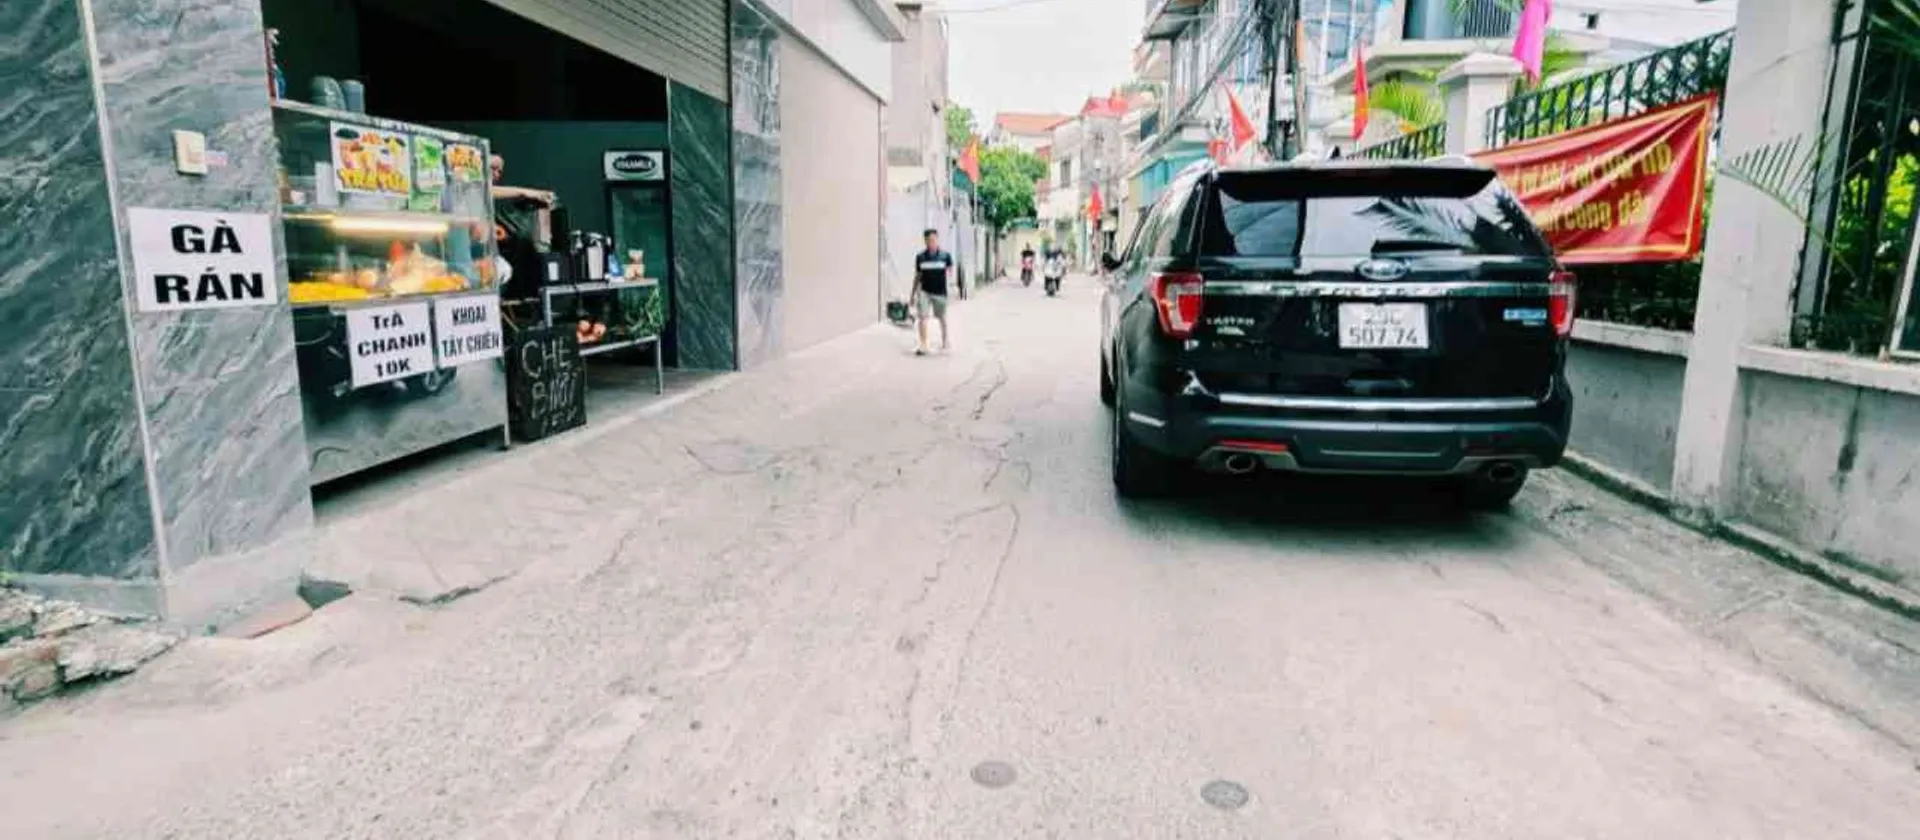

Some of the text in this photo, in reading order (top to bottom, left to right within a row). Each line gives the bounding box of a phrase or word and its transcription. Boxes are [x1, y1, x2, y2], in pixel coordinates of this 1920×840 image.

[171, 219, 242, 254] GÀ
[154, 266, 264, 304] RÁN
[452, 305, 486, 326] KHOAI
[357, 332, 426, 357] CHANH
[442, 334, 463, 358] TÂY
[374, 357, 410, 378] 10K
